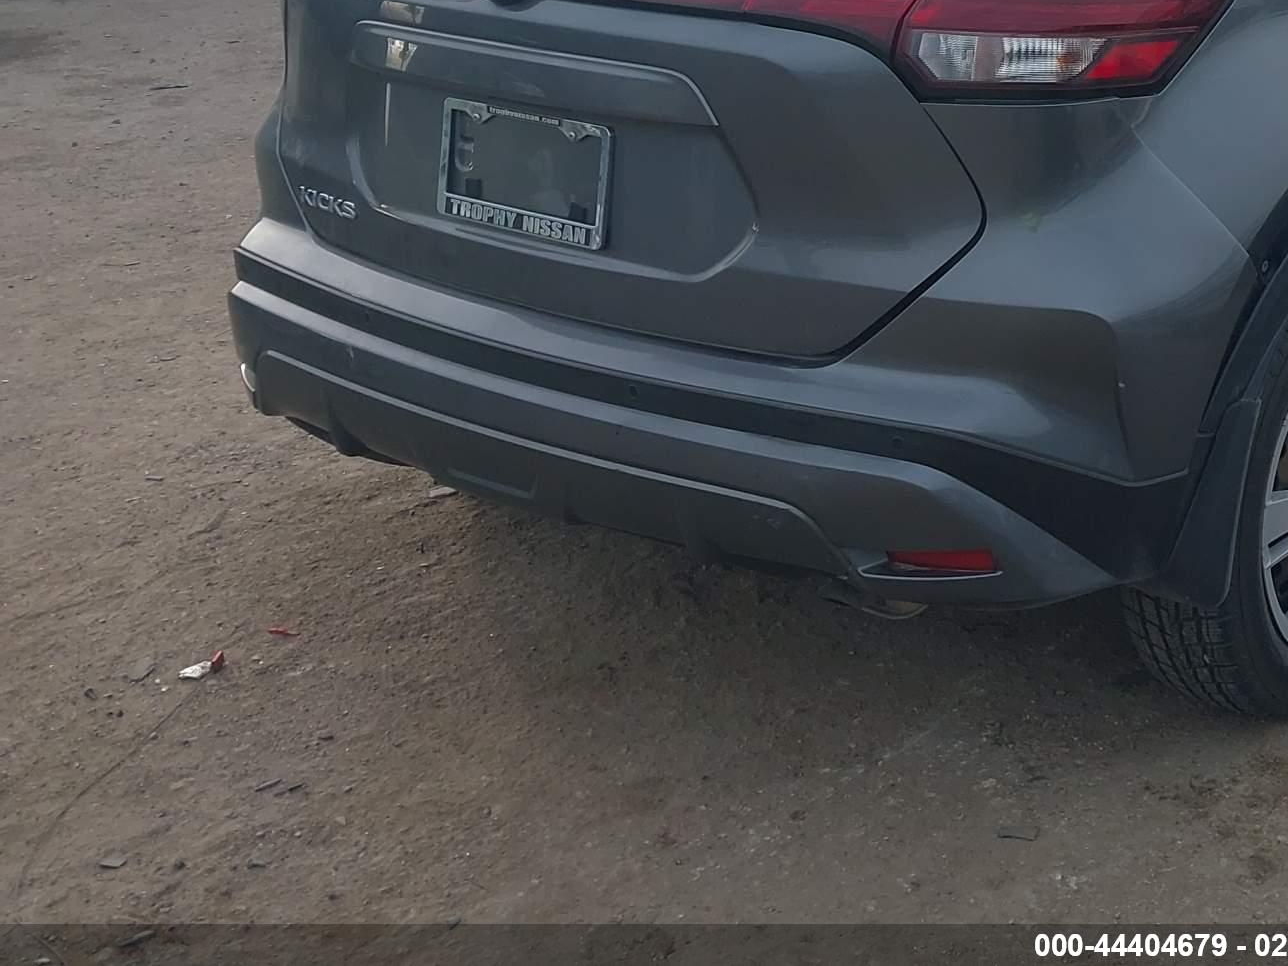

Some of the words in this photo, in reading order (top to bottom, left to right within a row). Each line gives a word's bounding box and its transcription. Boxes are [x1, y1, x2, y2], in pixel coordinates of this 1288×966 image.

[299, 186, 356, 219] KICKS
[450, 199, 517, 228] TROPHY
[522, 215, 587, 245] NISSAN
